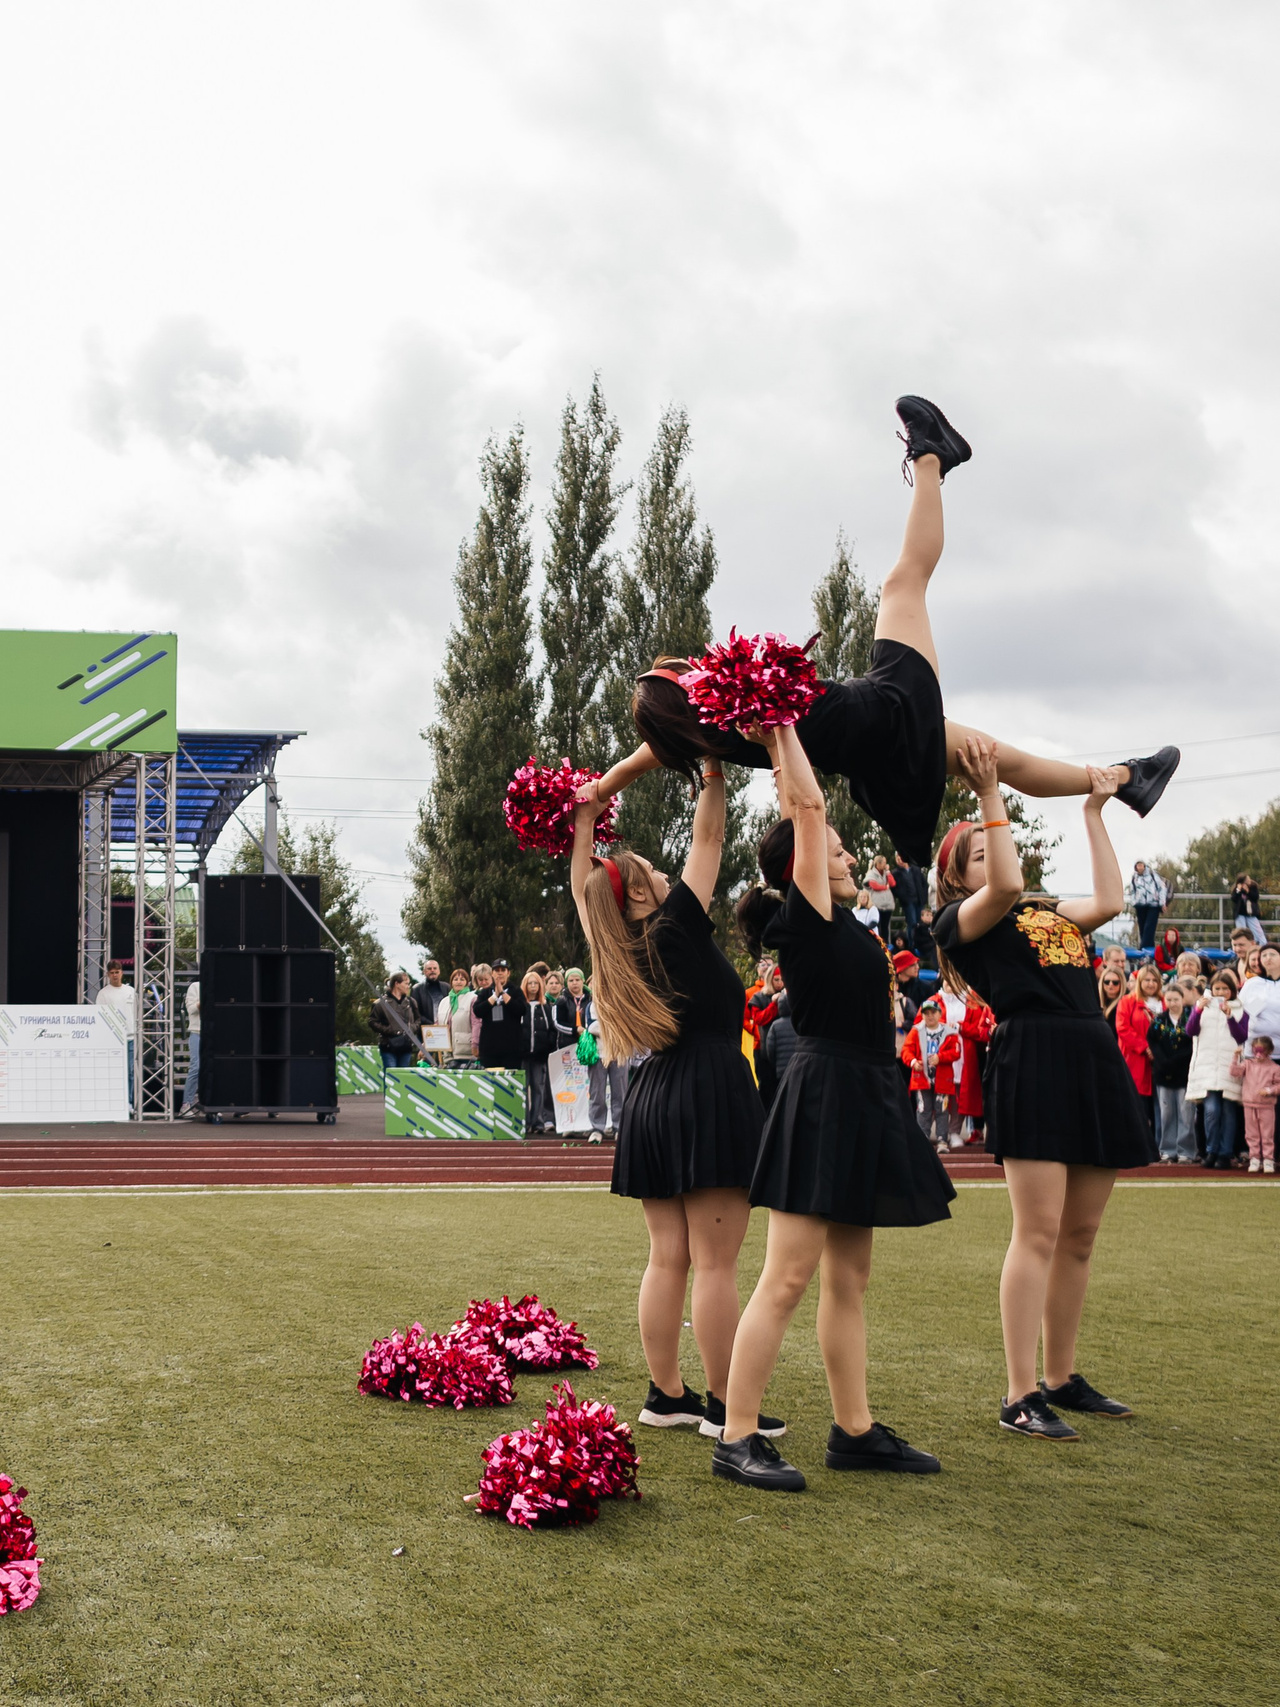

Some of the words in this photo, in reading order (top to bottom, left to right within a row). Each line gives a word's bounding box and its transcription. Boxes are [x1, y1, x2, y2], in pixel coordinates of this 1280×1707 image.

[19, 1015, 60, 1025] ТУРНИРНАЯ
[62, 1015, 96, 1025] ТАБЛИЦА
[71, 1030, 90, 1039] 2024
